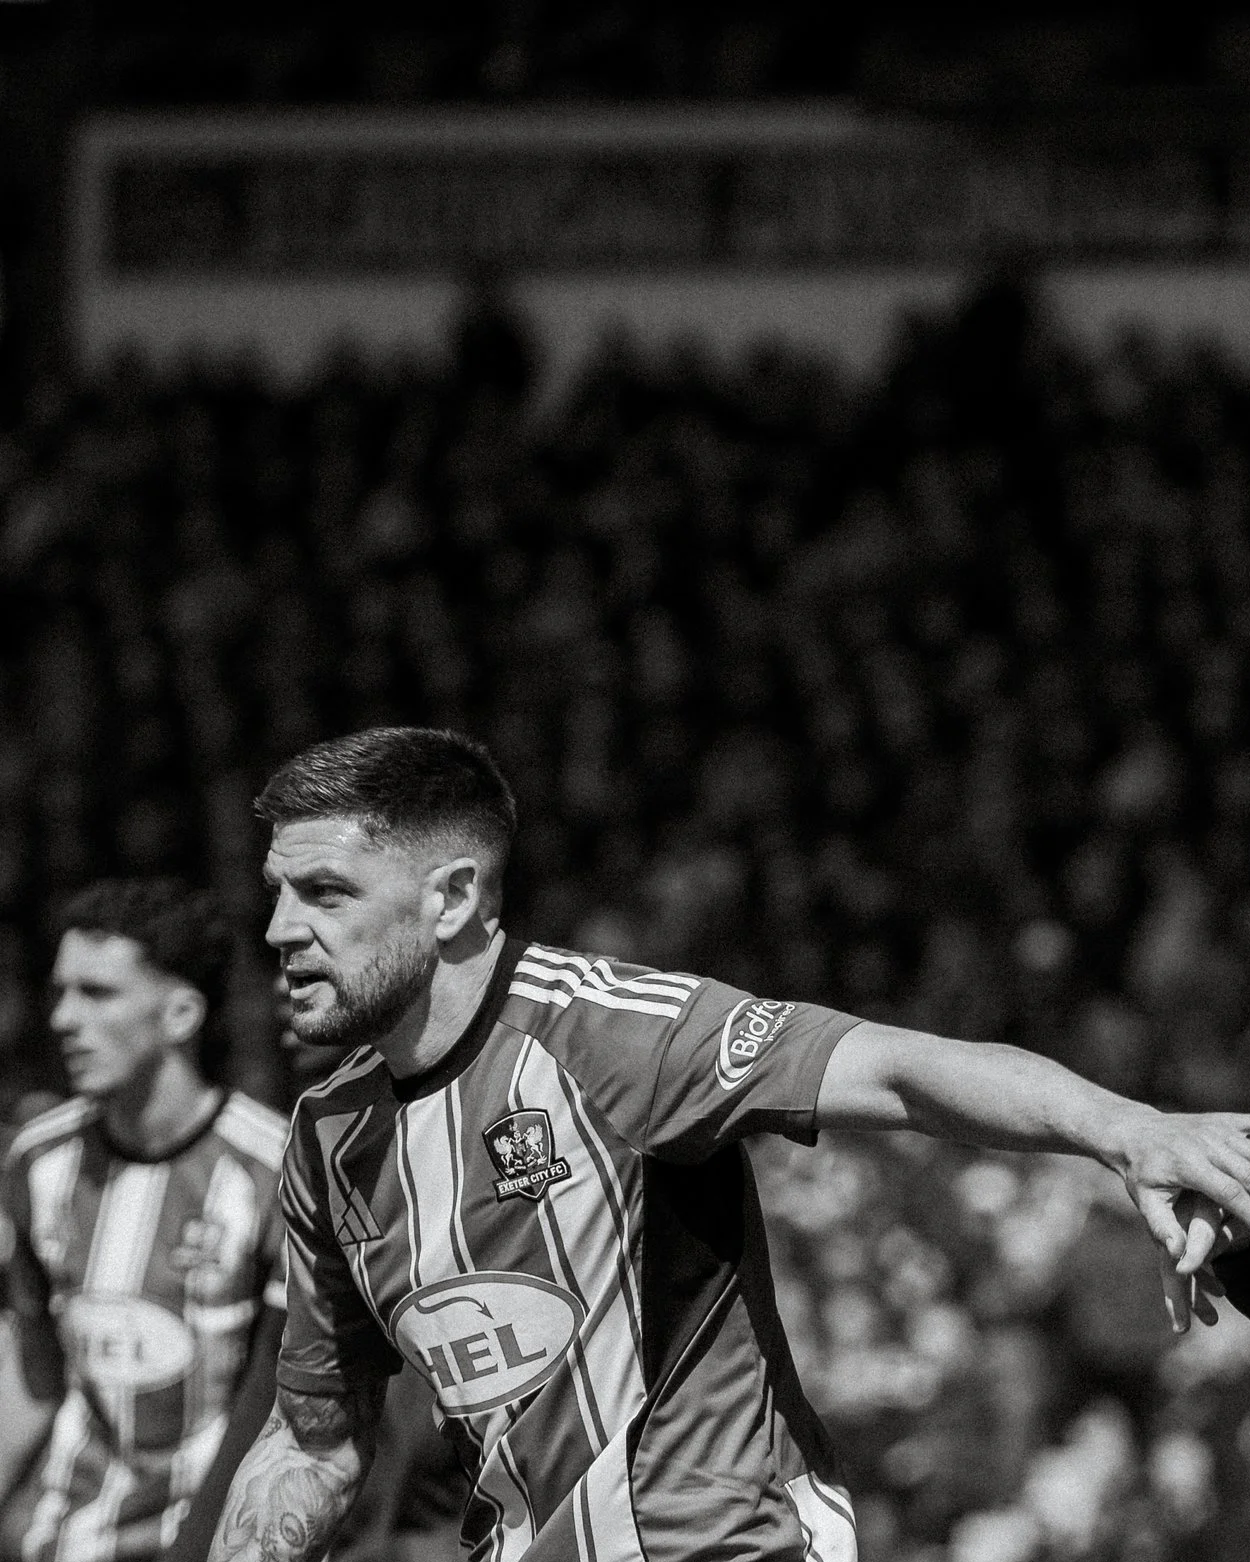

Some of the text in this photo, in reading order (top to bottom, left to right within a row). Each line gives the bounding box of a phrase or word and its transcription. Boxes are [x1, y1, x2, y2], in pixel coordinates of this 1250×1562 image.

[498, 1165, 564, 1194] EXETER CITY FC
